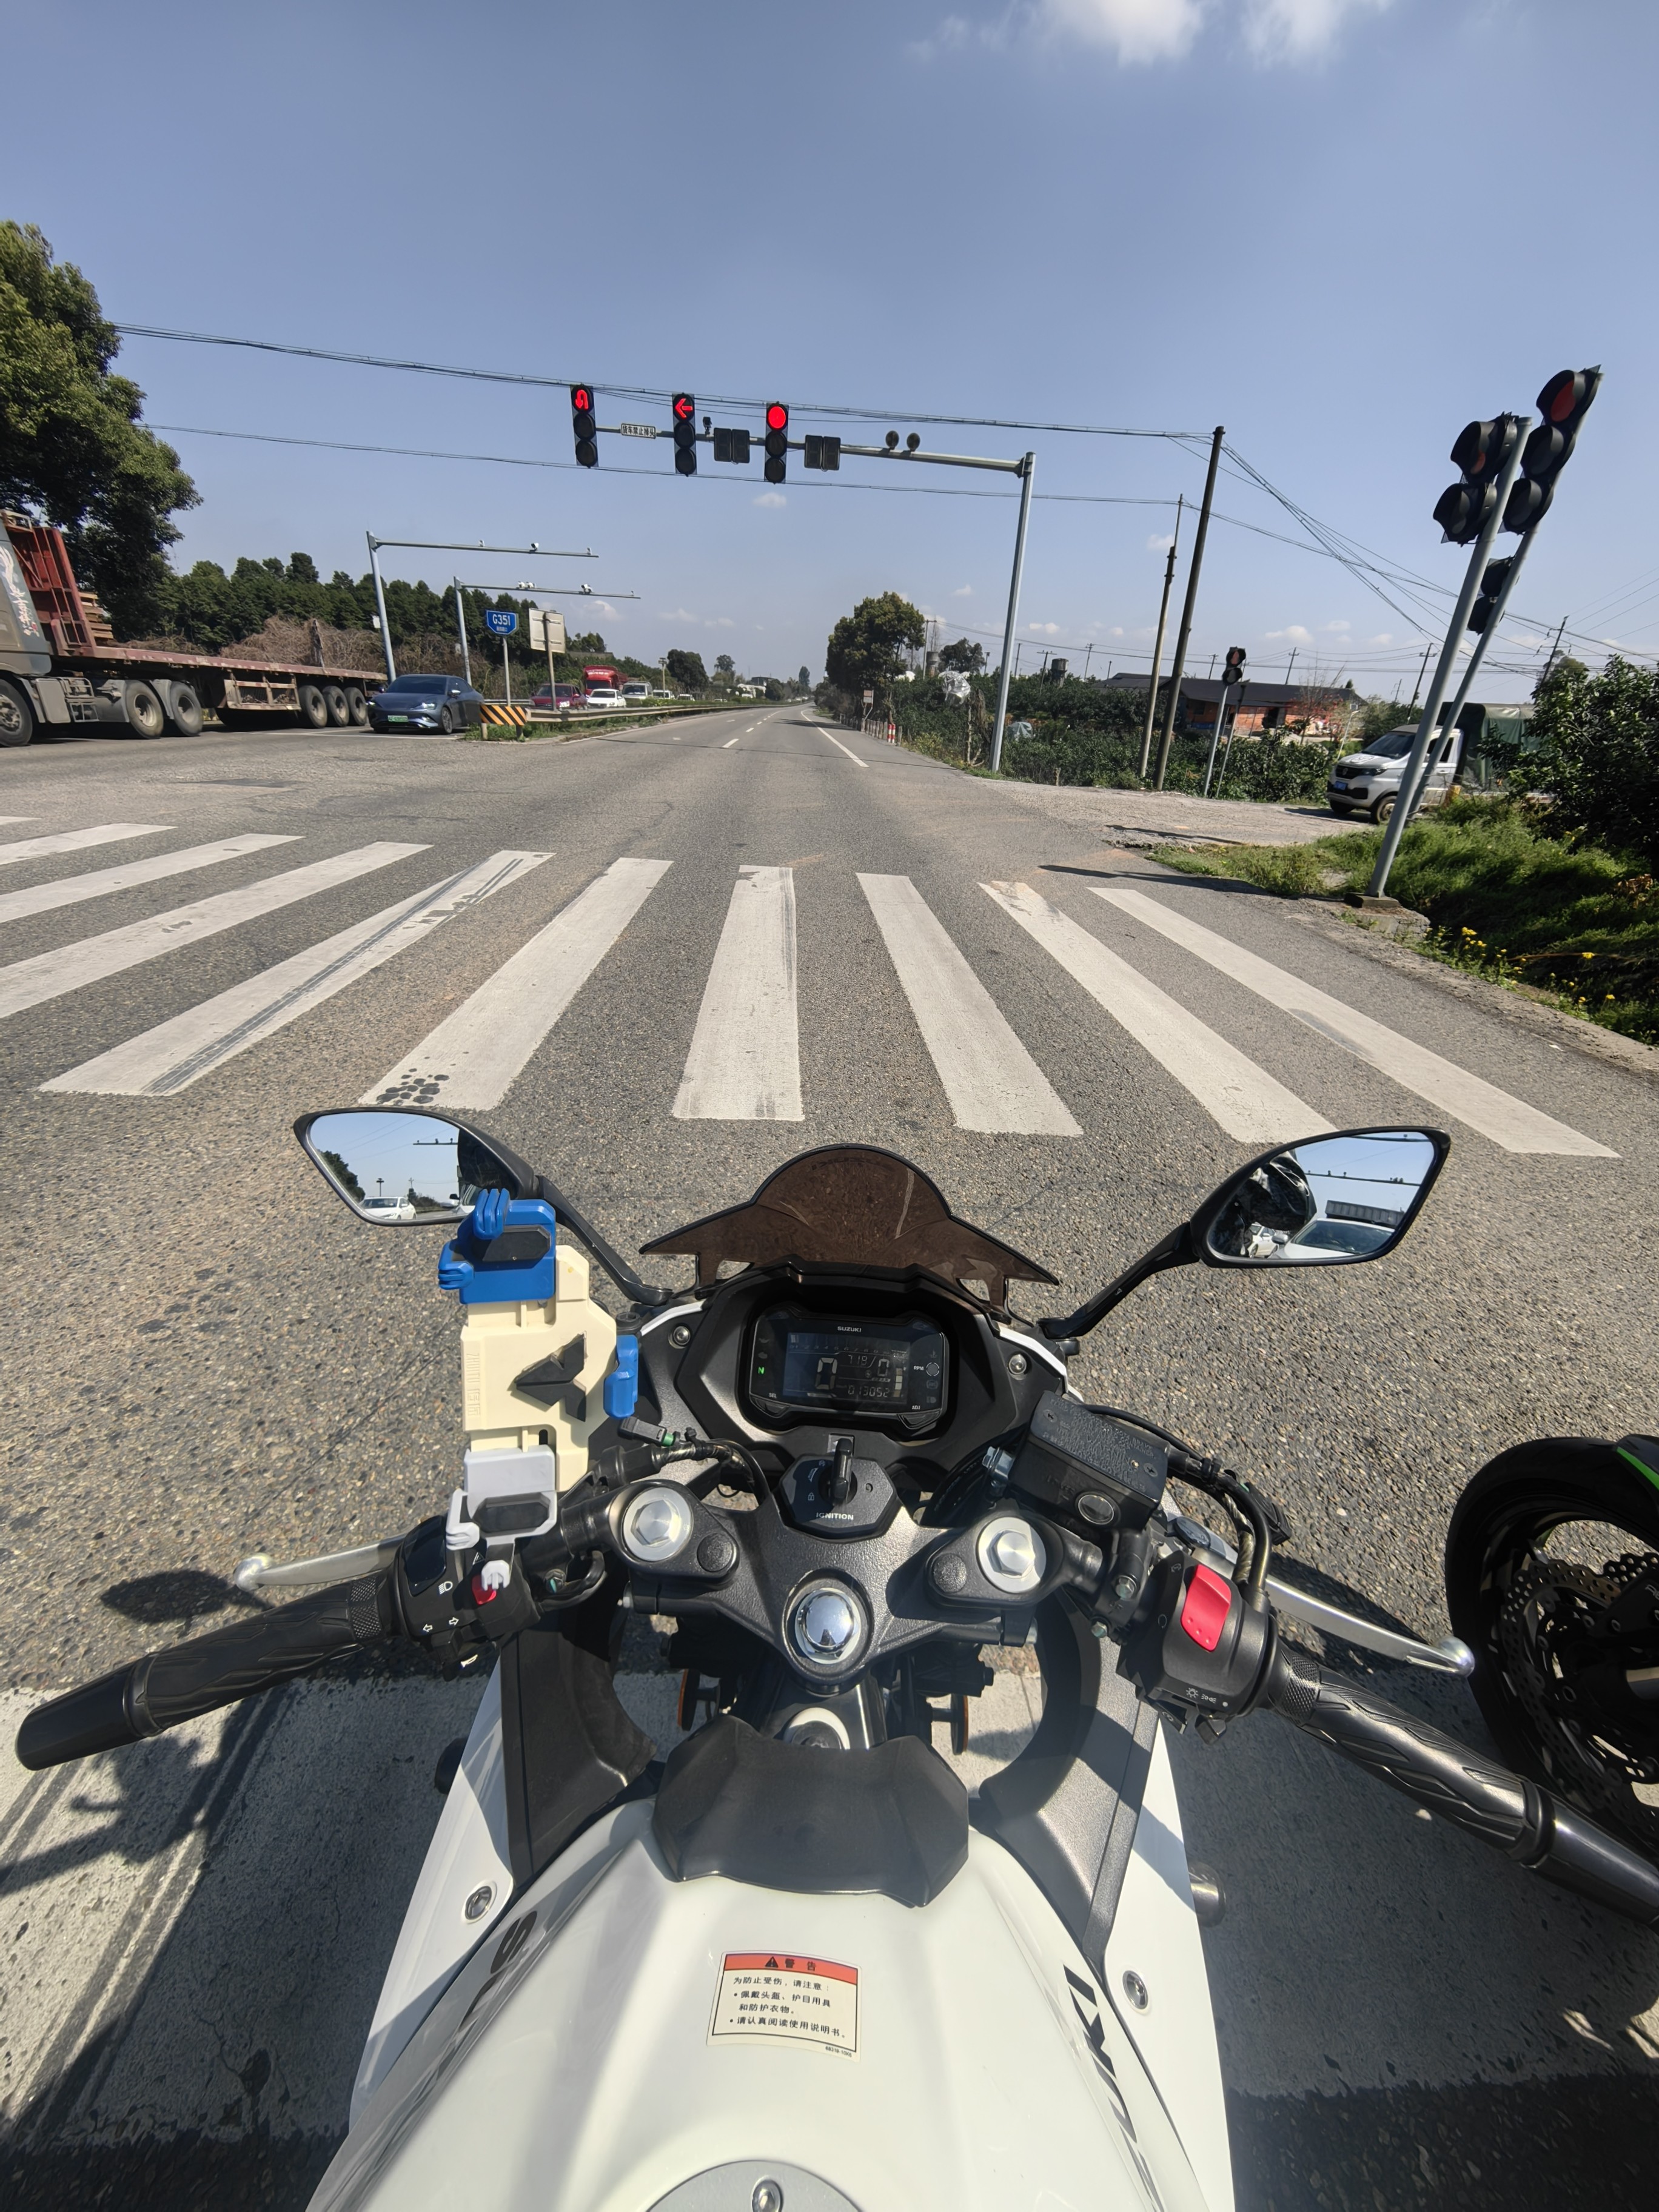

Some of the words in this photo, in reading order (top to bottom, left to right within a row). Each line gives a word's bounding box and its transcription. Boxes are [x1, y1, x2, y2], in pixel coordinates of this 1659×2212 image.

[492, 614, 511, 626] G351
[758, 1366, 765, 1375] N
[848, 1385, 890, 1398] 013052
[816, 1512, 854, 1520] IGNITION
